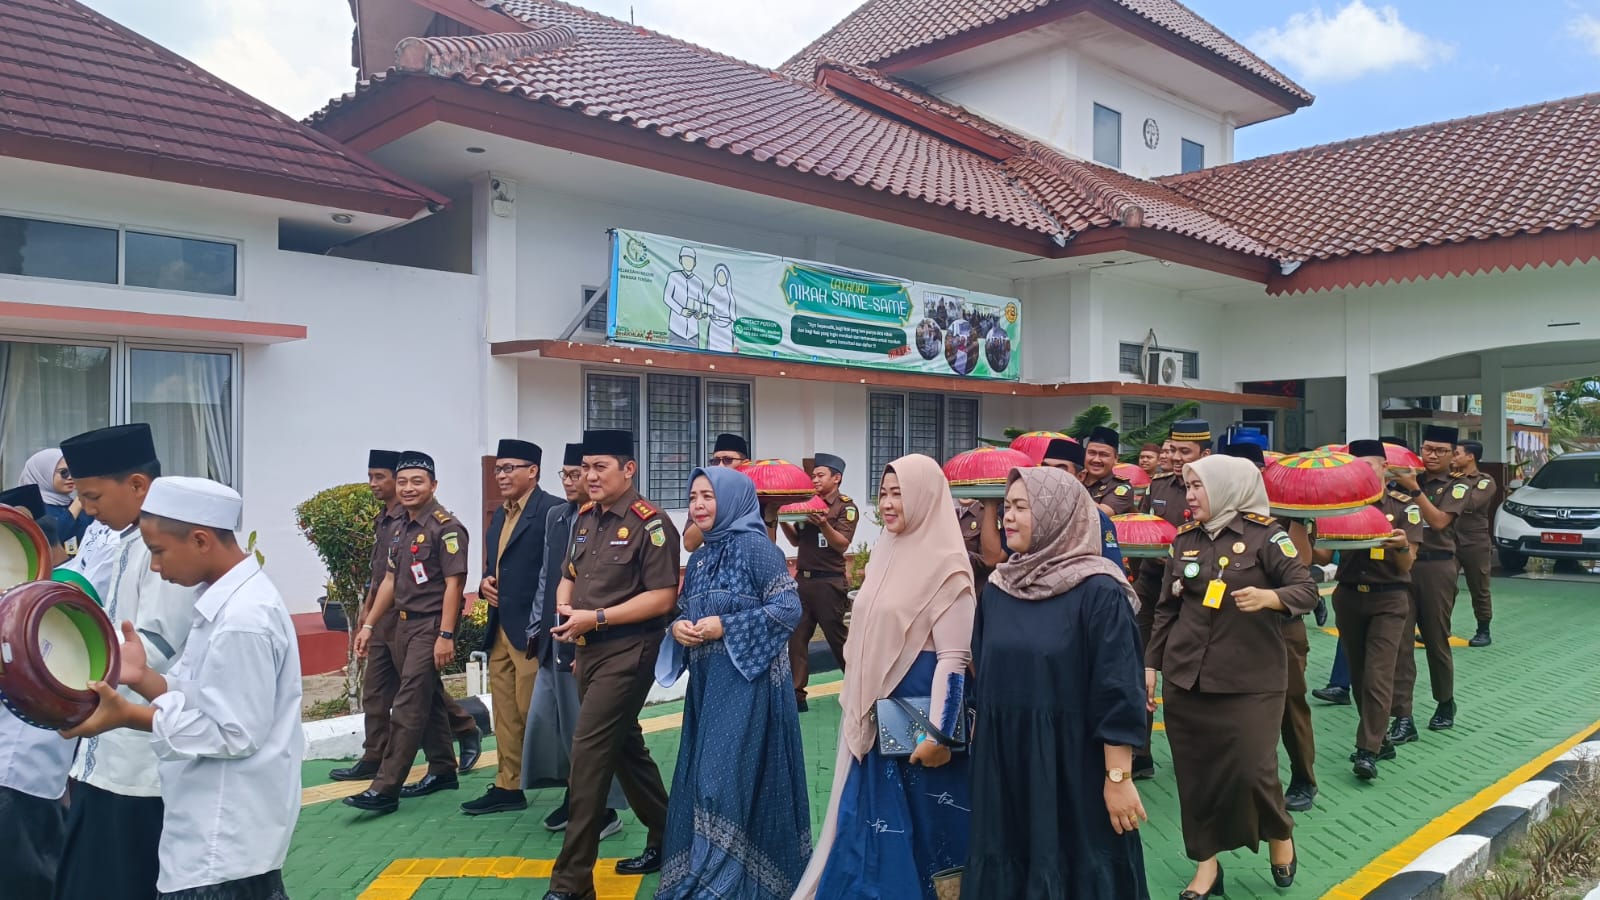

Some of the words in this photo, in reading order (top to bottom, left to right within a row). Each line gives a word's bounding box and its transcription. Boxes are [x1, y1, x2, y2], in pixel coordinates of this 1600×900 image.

[830, 278, 870, 295] LAYANAN
[788, 283, 828, 304] NIKAH
[831, 290, 908, 316] SAME-SAME
